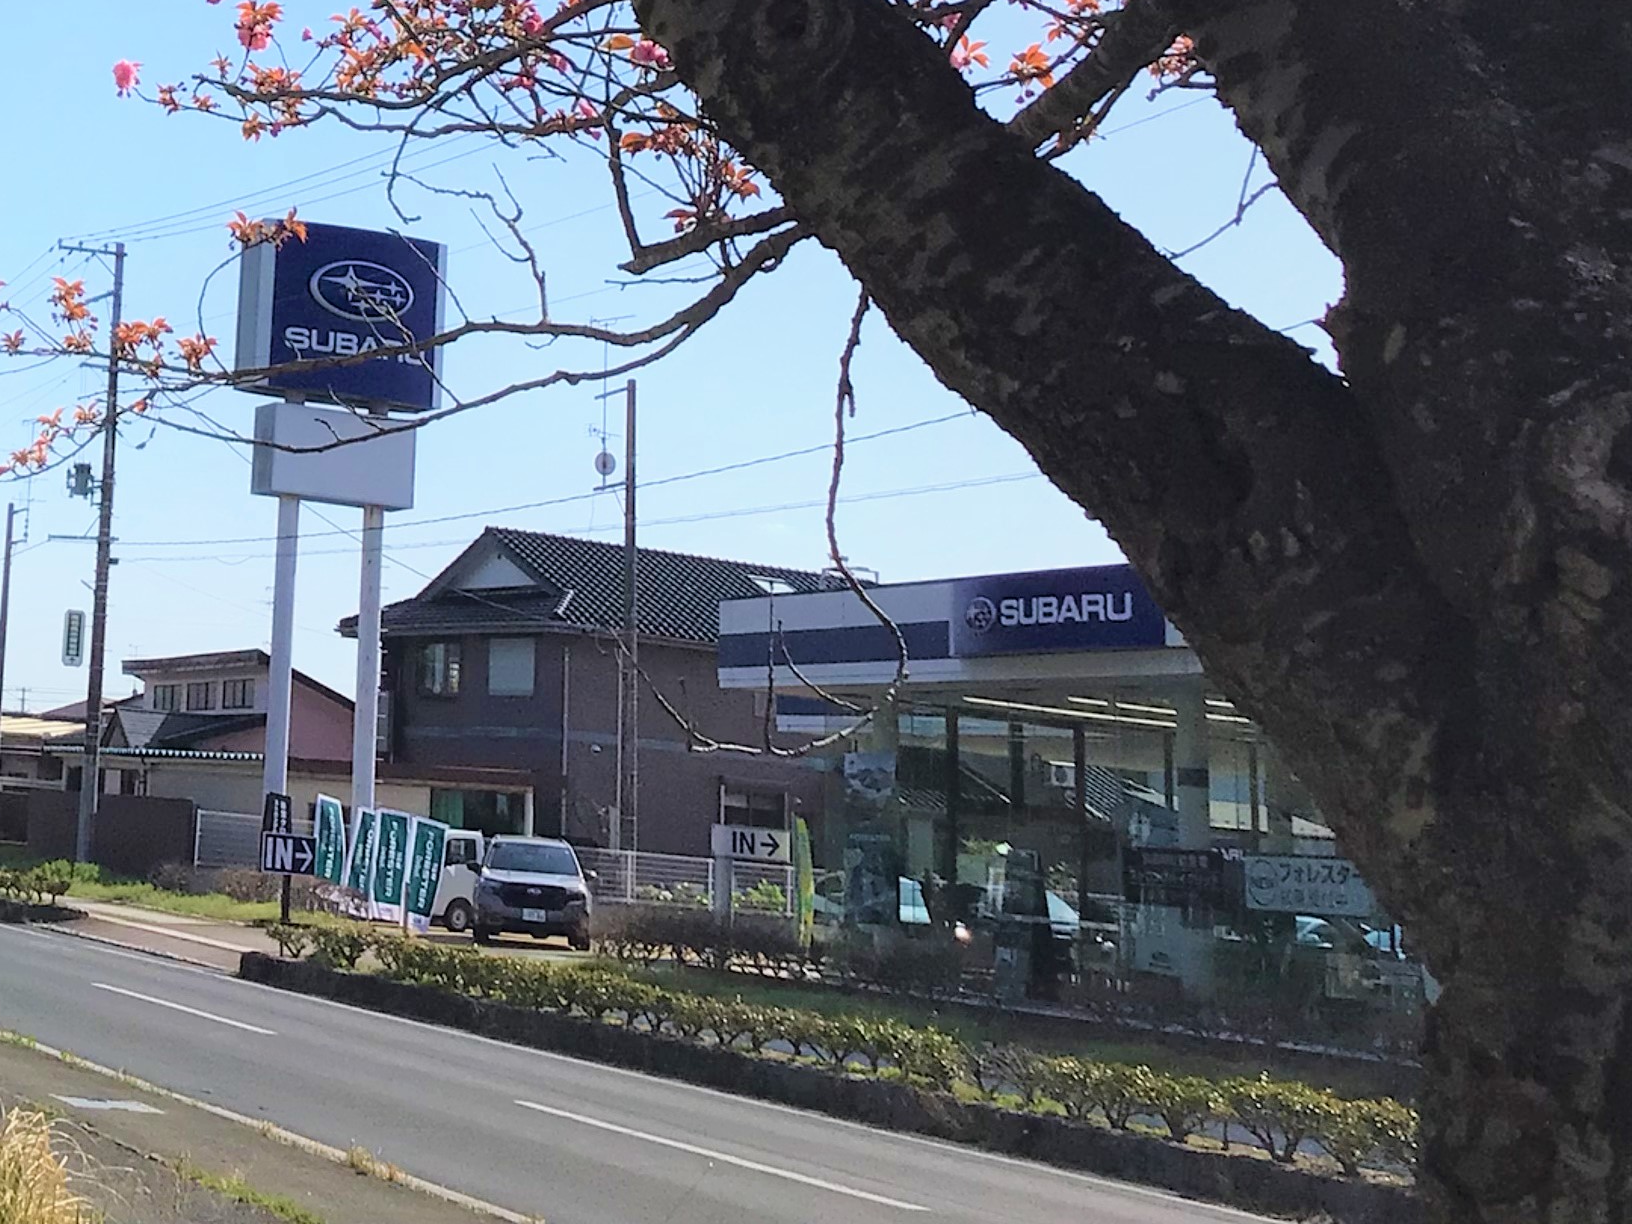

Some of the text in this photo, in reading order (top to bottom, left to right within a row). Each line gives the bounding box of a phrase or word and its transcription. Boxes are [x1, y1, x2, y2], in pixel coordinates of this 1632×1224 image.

[999, 591, 1133, 626] SUBARU
[265, 836, 294, 871] IN
[732, 830, 755, 855] IN
[417, 830, 435, 909] FORESTER
